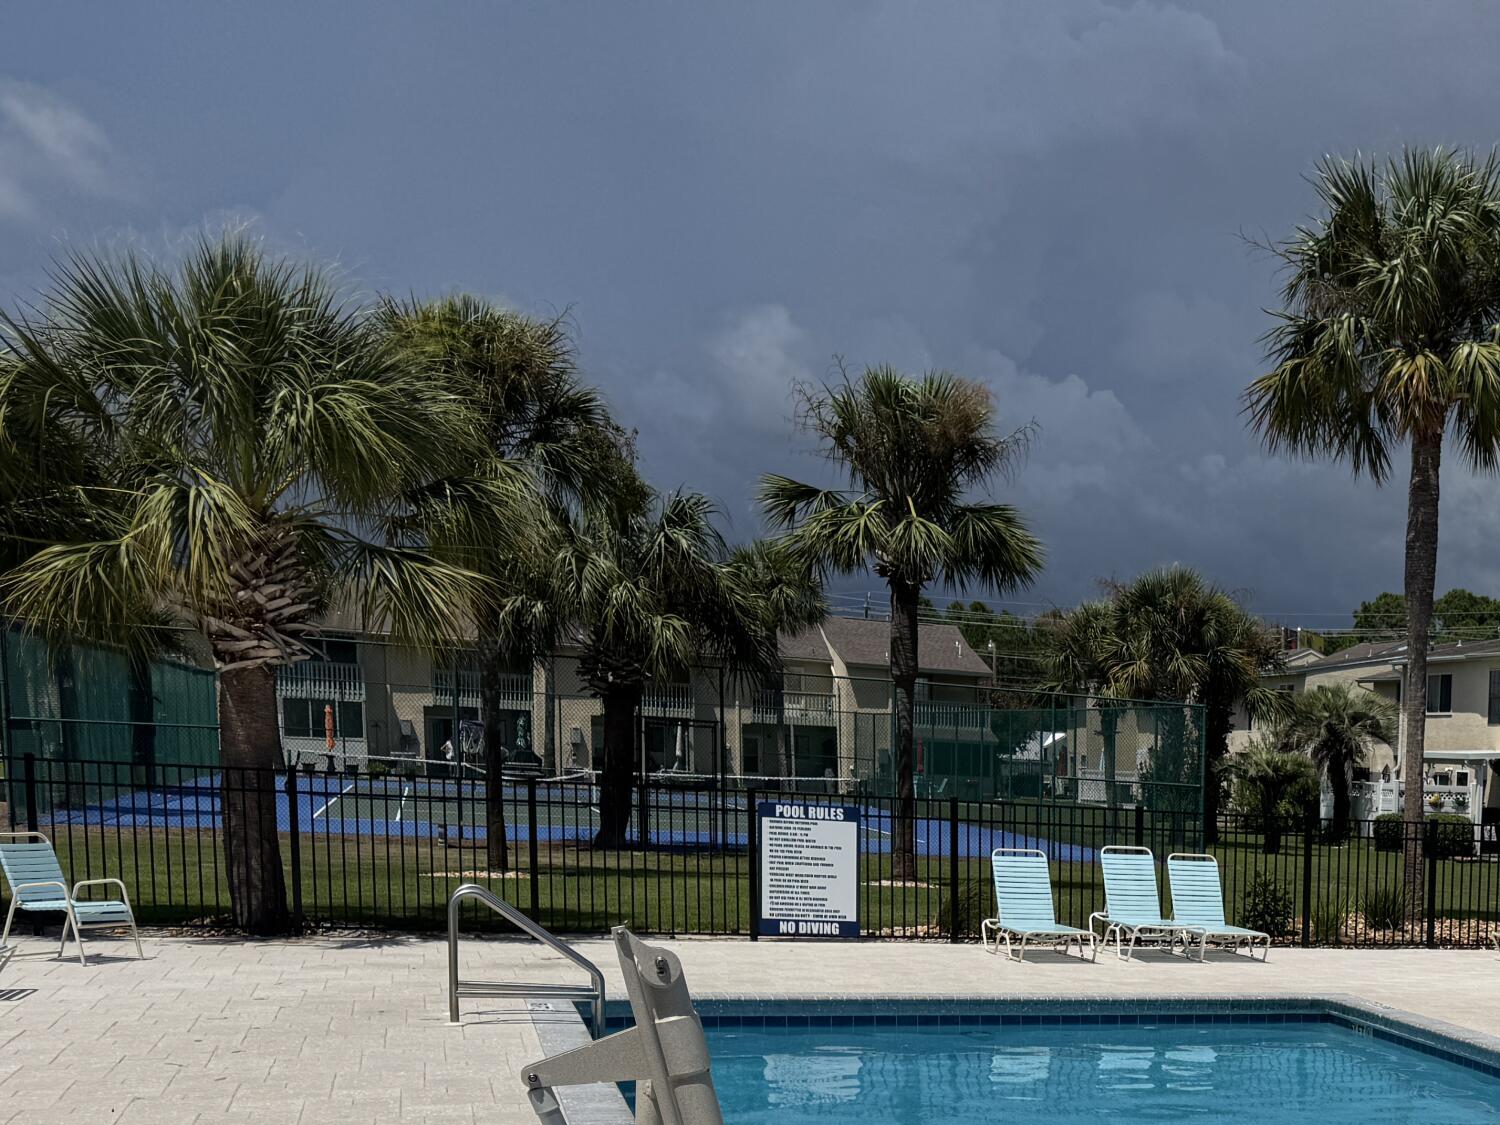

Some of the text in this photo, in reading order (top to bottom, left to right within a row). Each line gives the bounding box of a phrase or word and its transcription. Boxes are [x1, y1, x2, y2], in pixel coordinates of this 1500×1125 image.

[775, 804, 844, 821] POOL RULES
[779, 921, 840, 935] NO DIVING
